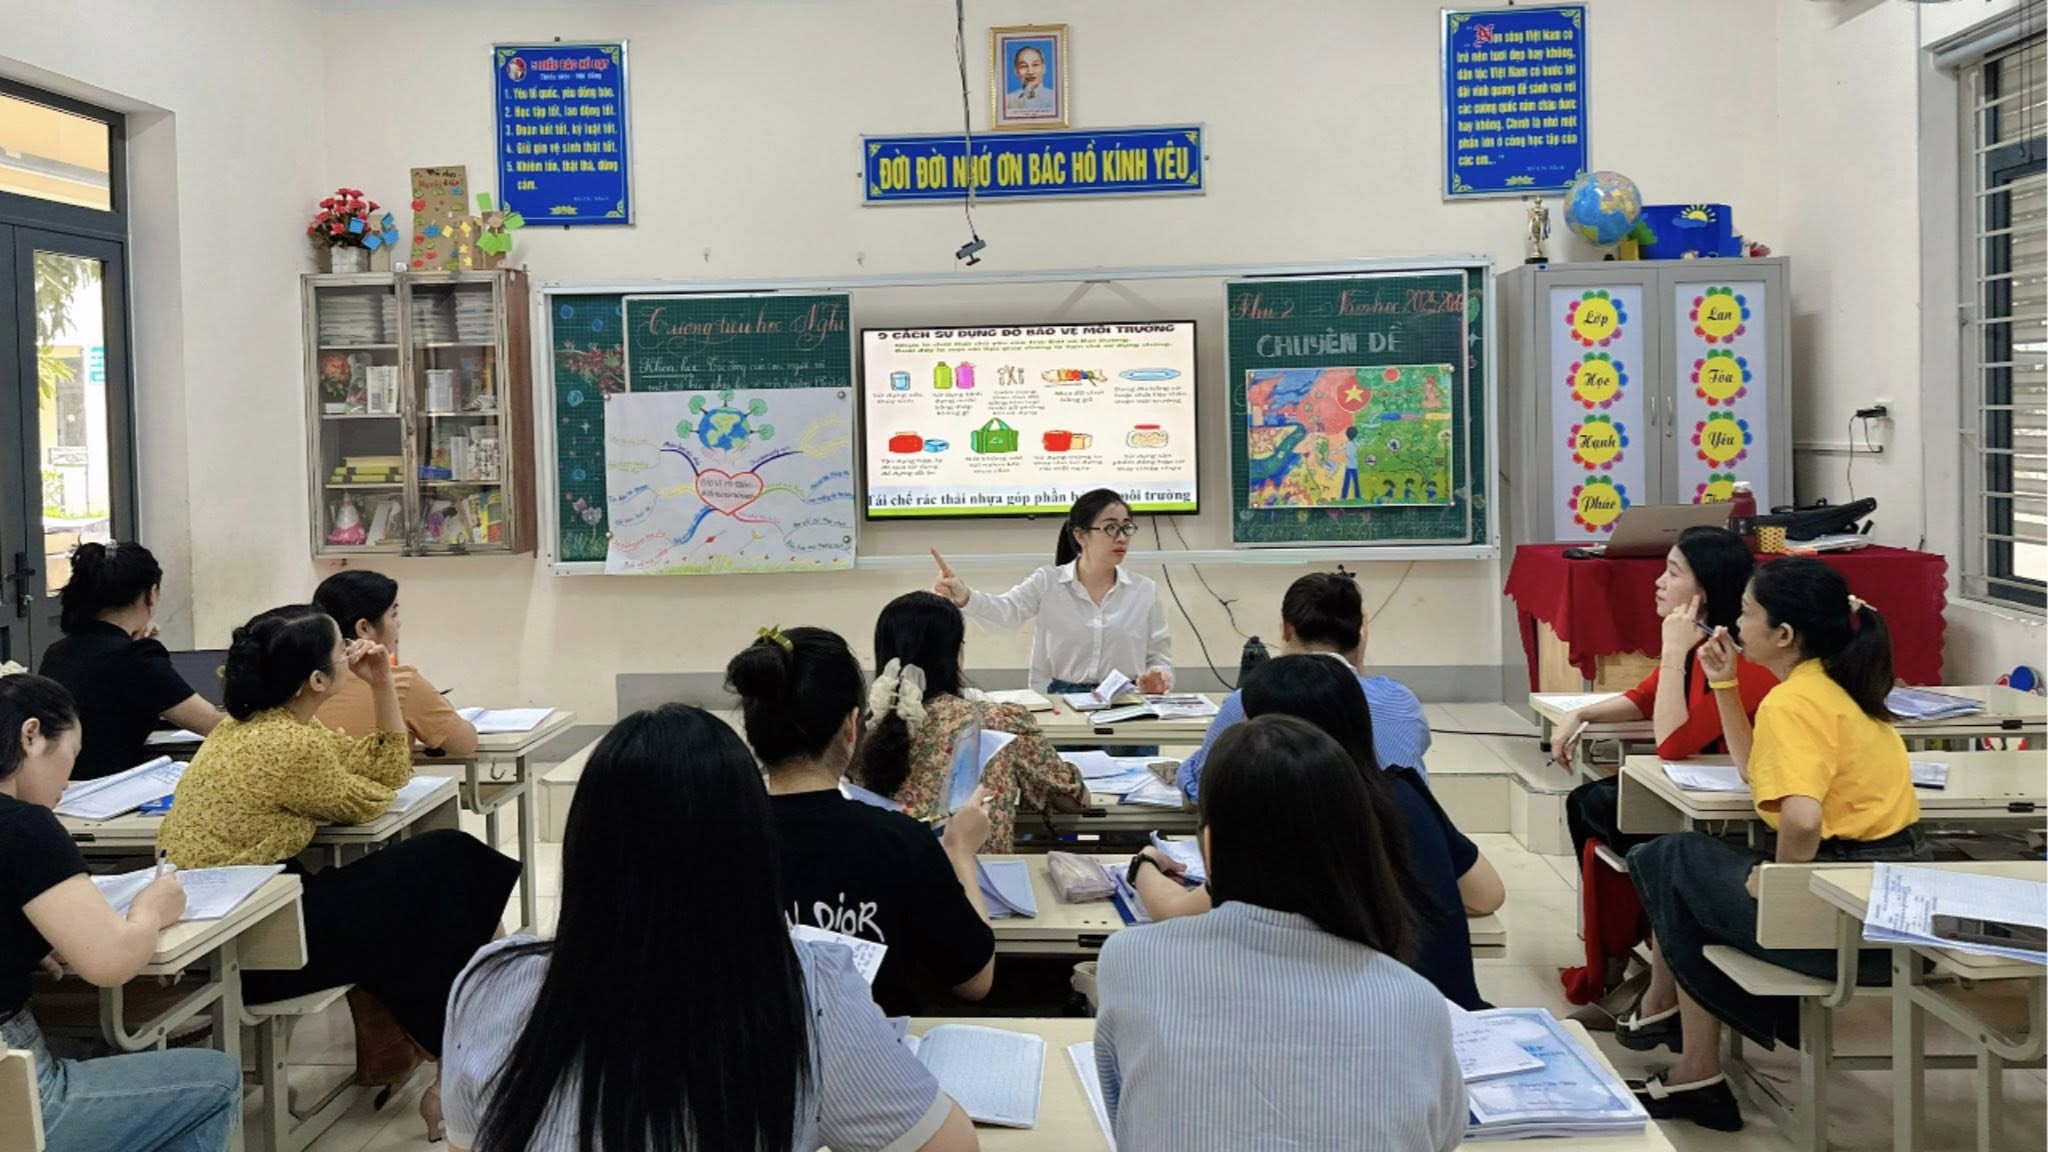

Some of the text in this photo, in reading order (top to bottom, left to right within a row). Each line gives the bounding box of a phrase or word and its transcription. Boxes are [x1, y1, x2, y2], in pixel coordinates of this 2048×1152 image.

[879, 139, 1189, 190] ĐỜI ĐỜI NHỚ ƠN BÁC HỒ KÍNH YÊU
[1583, 311, 1609, 326] Lớp
[1707, 307, 1732, 321] Lan
[958, 329, 997, 340] DỤNG
[1256, 327, 1357, 357] CHUYÊN
[1579, 434, 1616, 450] Hạnh
[1708, 431, 1735, 448] Yêu
[868, 494, 887, 506] Tái
[890, 491, 912, 506] chế
[916, 494, 937, 505] rác
[941, 493, 966, 505] thải
[970, 493, 1003, 506] nhựa
[1007, 490, 1030, 507] góp
[1034, 488, 1067, 505] phần
[1145, 490, 1191, 503] trường
[1582, 495, 1617, 513] Phúc
